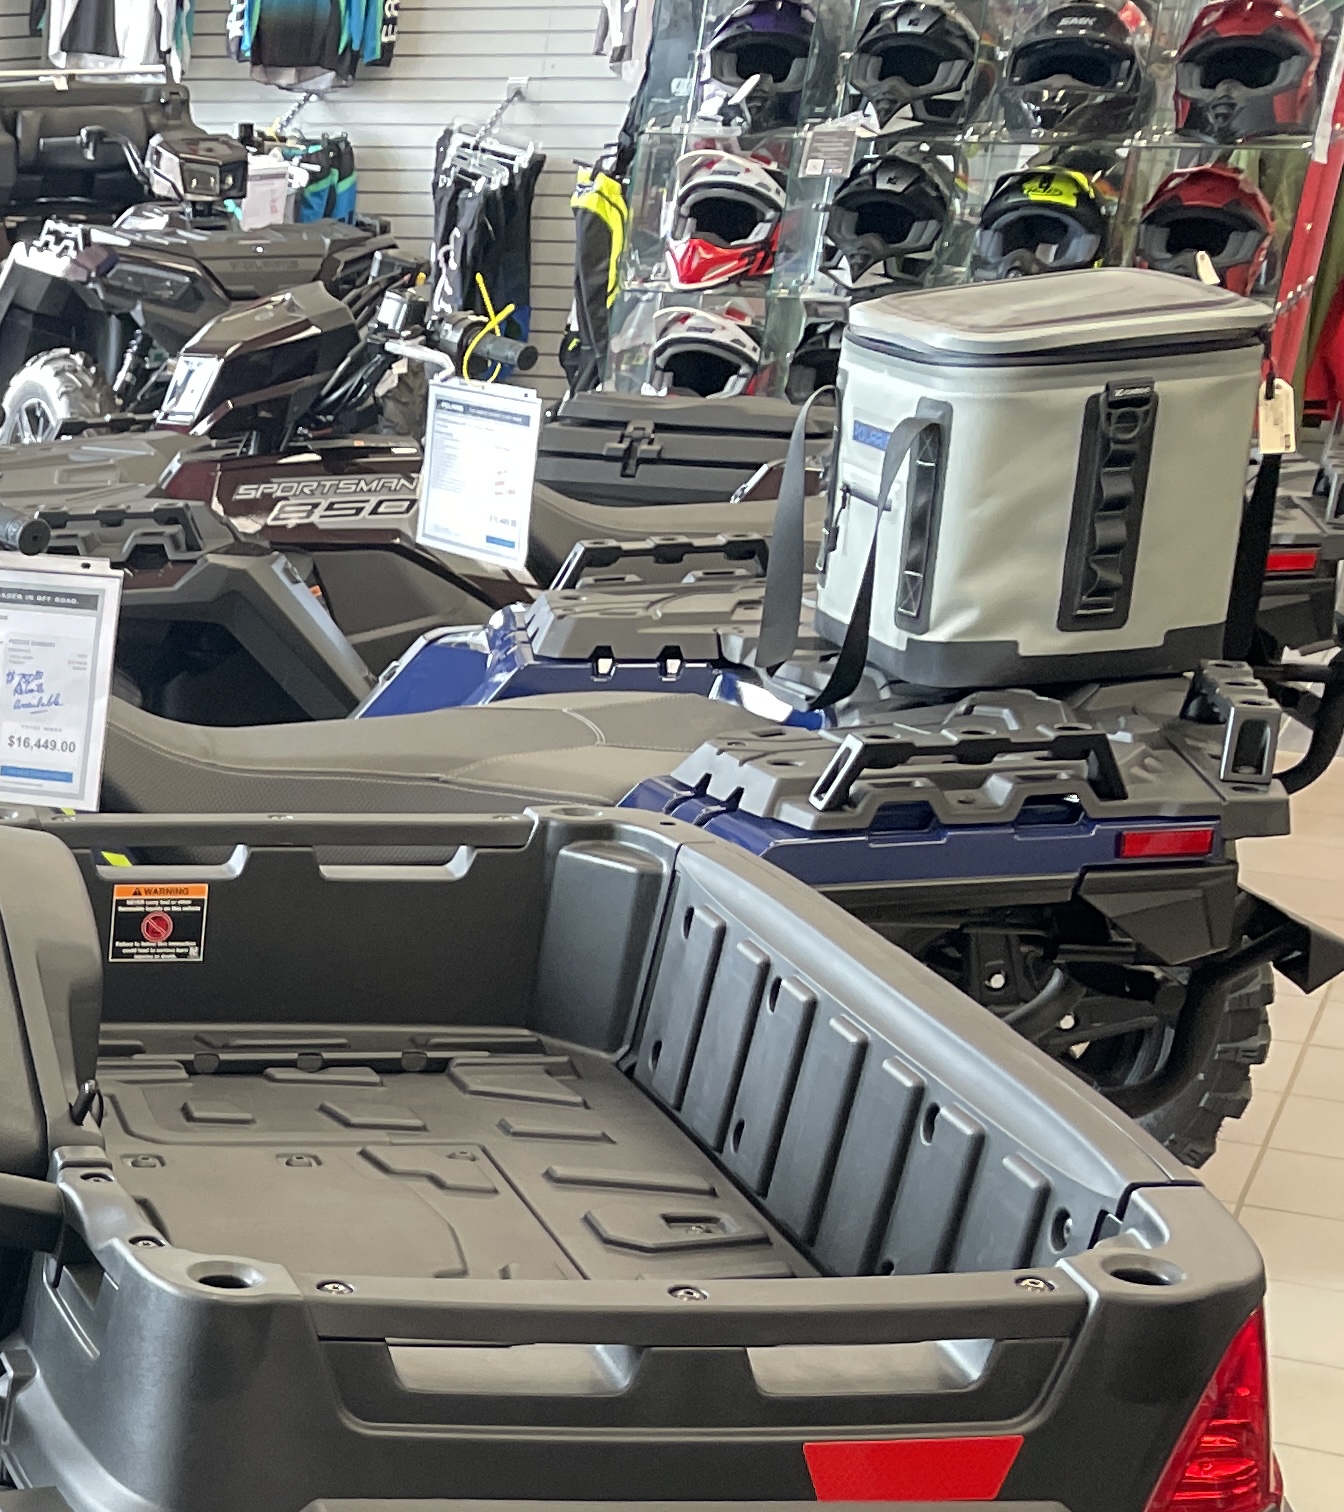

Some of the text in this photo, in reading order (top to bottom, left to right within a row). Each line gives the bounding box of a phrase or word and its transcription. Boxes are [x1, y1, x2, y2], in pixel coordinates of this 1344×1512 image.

[233, 473, 421, 500] SPORTSMAN
[265, 498, 419, 527] 850
[7, 734, 76, 753] $16,449.00
[143, 887, 190, 896] WARNING
